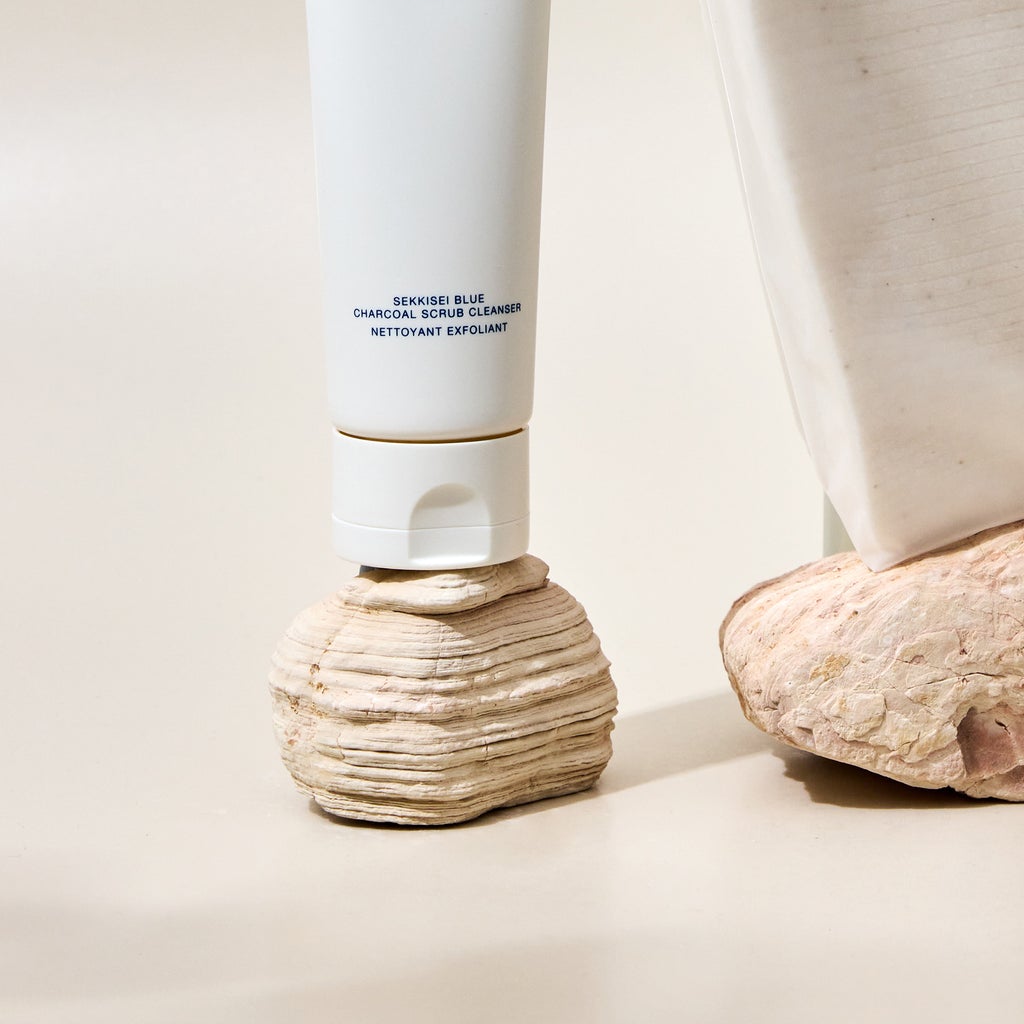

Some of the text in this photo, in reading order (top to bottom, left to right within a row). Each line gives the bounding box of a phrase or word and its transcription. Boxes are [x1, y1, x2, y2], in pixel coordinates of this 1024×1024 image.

[393, 294, 485, 306] SEKKISEI BLUE
[353, 302, 522, 319] CHARCOAL SCRUB CLEANSER
[371, 322, 508, 337] NETTOYANT EXFOLIANT
